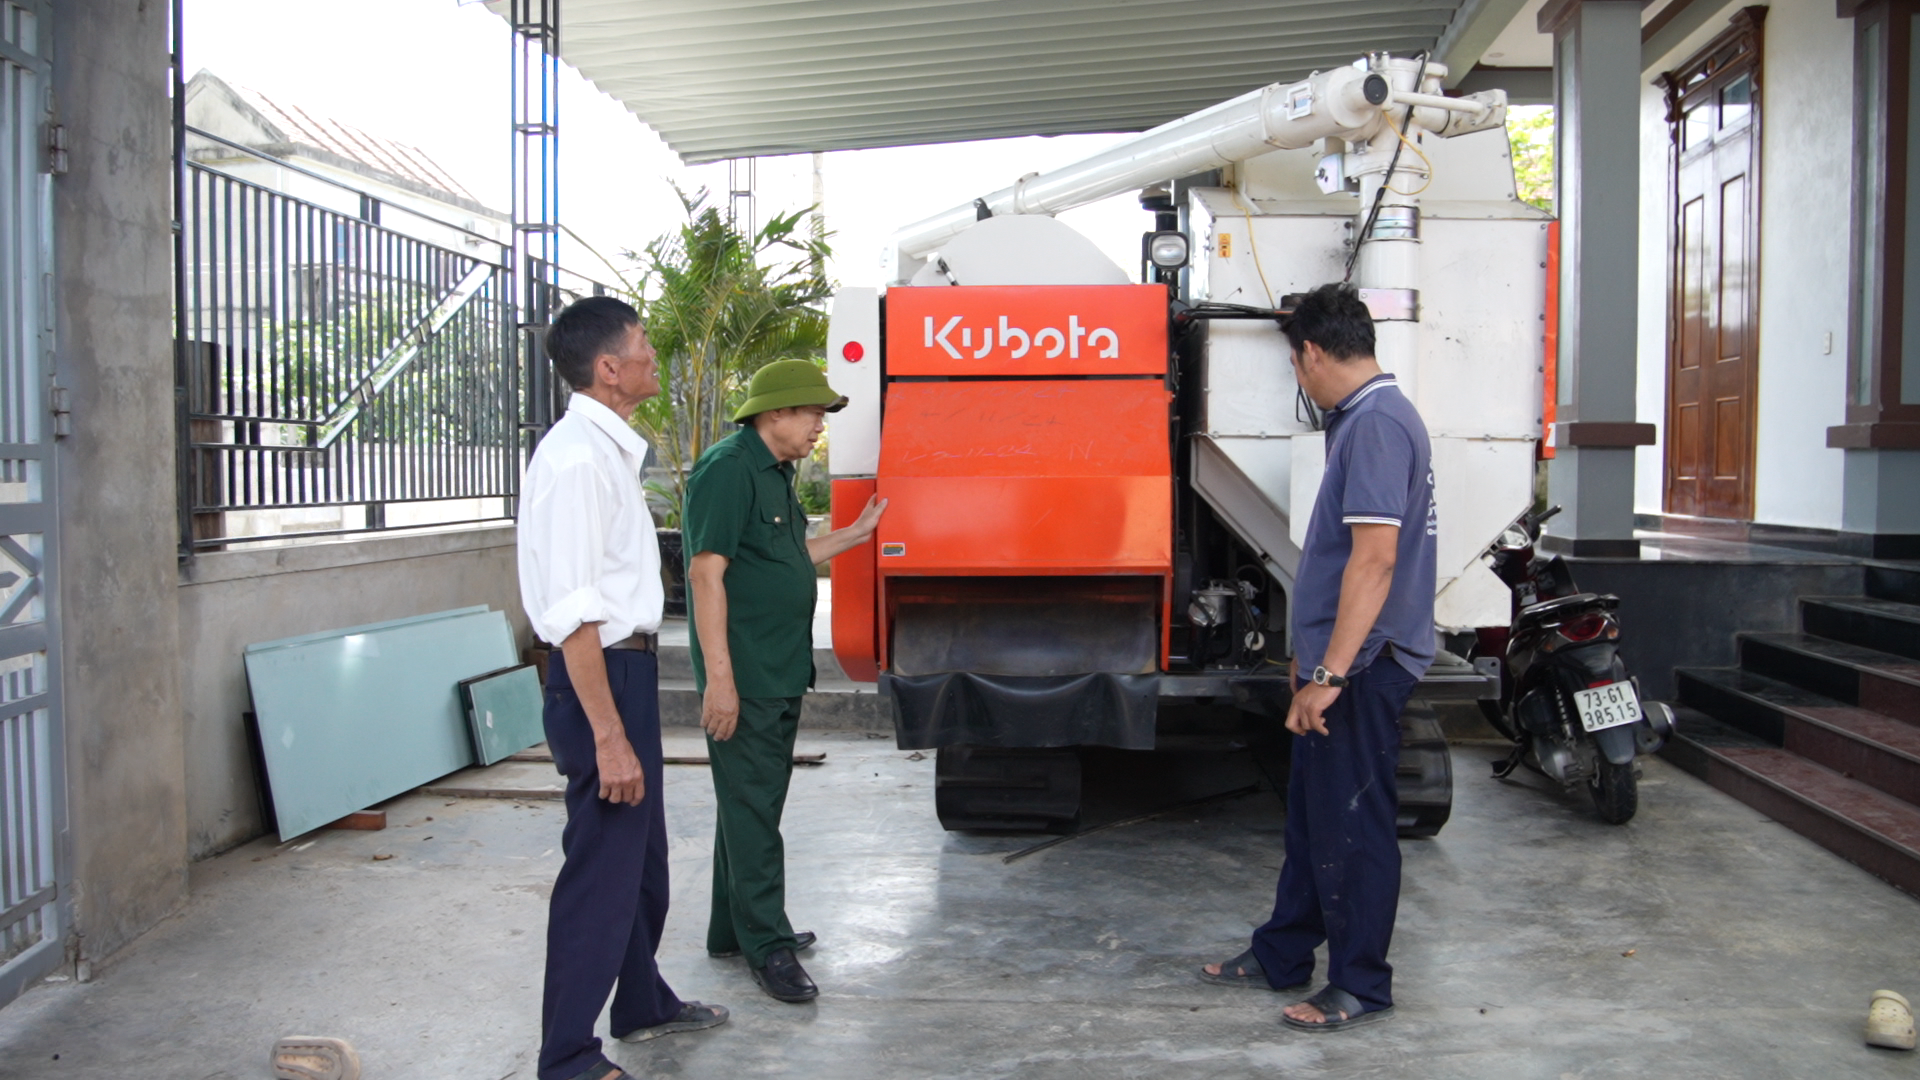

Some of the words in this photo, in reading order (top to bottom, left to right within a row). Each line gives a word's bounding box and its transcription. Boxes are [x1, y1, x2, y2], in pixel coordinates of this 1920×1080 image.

[924, 315, 1119, 359] Kubota
[1583, 686, 1624, 709] 73-G1
[1584, 701, 1637, 729] 385.15
